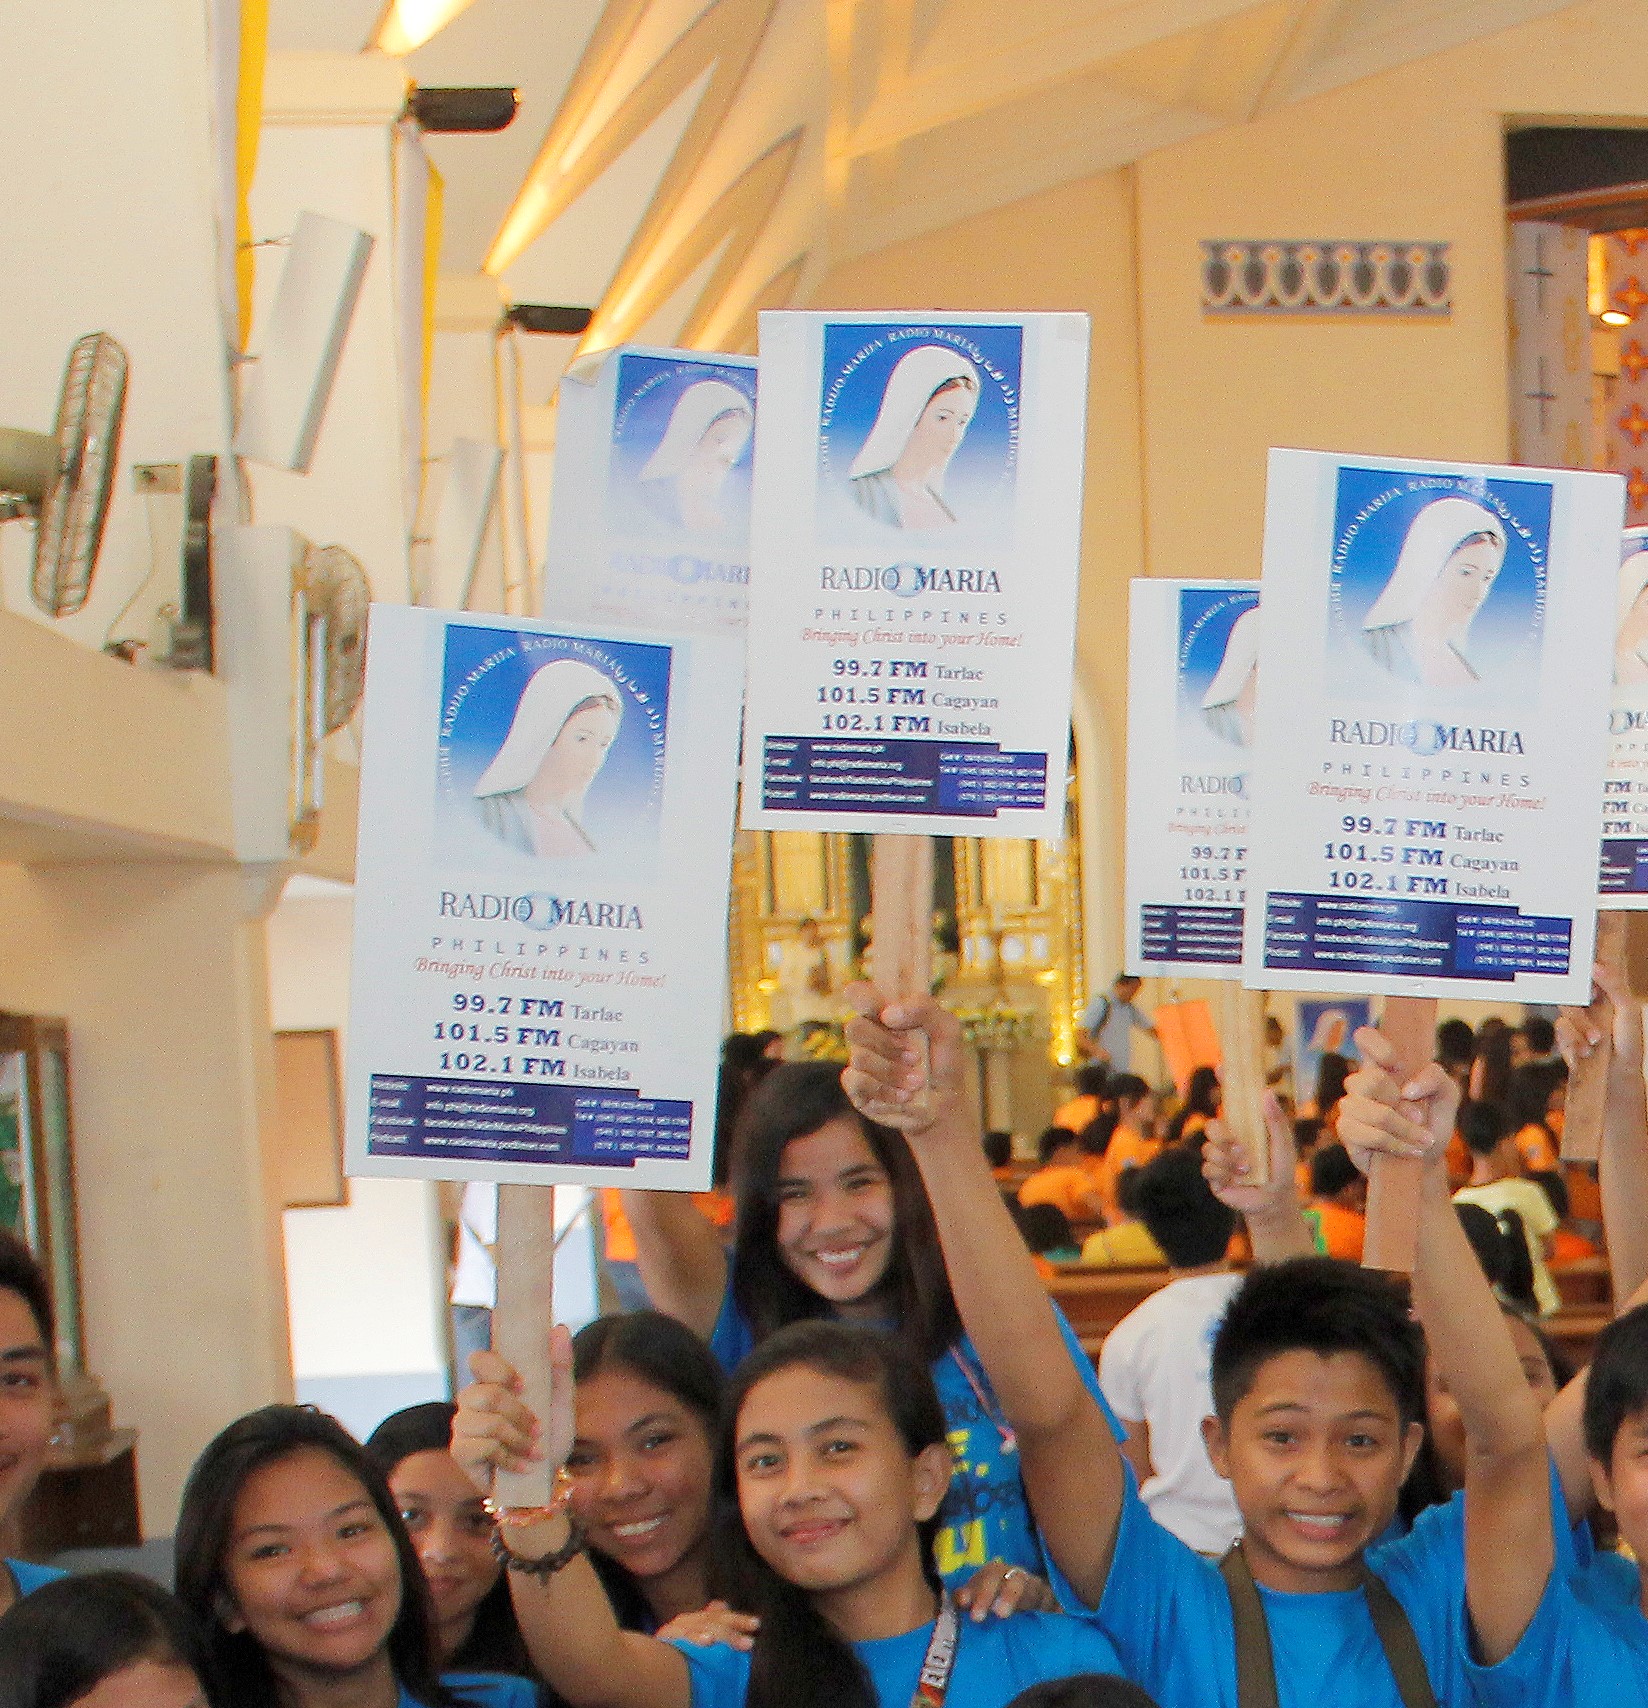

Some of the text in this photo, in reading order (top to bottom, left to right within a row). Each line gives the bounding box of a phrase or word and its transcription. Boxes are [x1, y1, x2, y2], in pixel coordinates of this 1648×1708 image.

[821, 566, 1002, 593] RADIO MARIA
[815, 609, 1006, 624] PHILIPPINES
[832, 658, 883, 678] 99.7
[889, 660, 929, 679] FM
[817, 685, 881, 705] 101.5
[886, 688, 926, 706] FM
[822, 712, 884, 732] 102.1
[892, 715, 931, 734] FM
[1330, 719, 1525, 755] RADIO MARIA
[1181, 775, 1243, 795] RADIO
[1323, 762, 1530, 787] PHILIPPINES
[1603, 780, 1632, 794] FM
[1602, 800, 1629, 815] FM
[1342, 815, 1398, 836] 99.7
[1404, 819, 1447, 839] FM
[1603, 821, 1632, 834] FM
[1323, 842, 1395, 864] 101.5
[1401, 847, 1444, 866] FM
[1180, 867, 1230, 882] 101.5
[1329, 870, 1398, 892] 102.1
[1406, 875, 1449, 895] FM
[1184, 888, 1232, 902] 102.1
[440, 891, 644, 931] RADIO MARIA
[432, 936, 649, 964] PHILIPPINES
[453, 992, 513, 1015] 99.7
[519, 997, 564, 1018] FM
[433, 1022, 509, 1044] 101.5
[516, 1027, 561, 1047] FM
[439, 1051, 513, 1074] 102.1
[522, 1056, 566, 1078] FM
